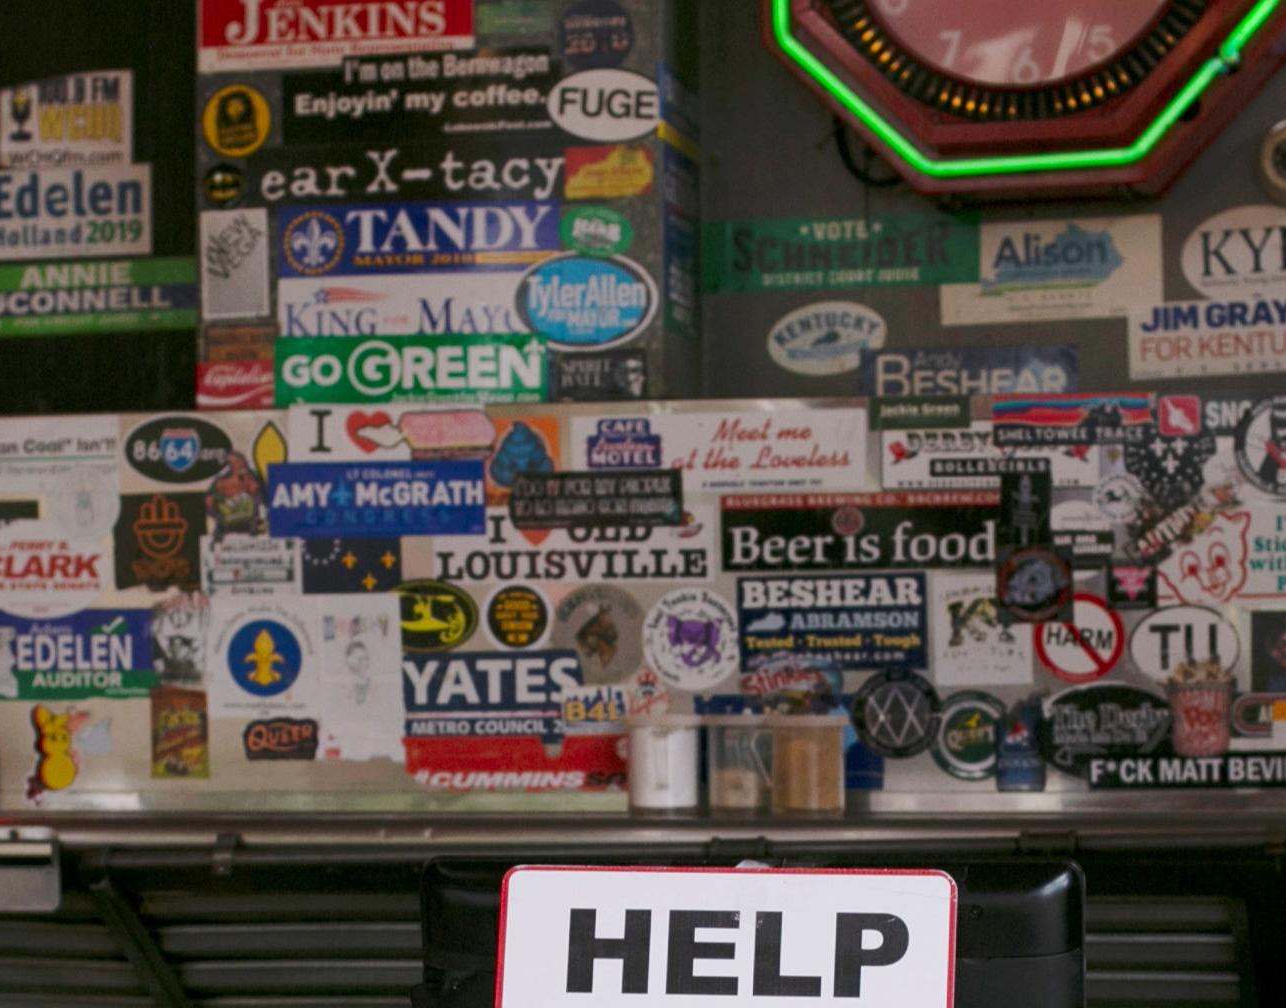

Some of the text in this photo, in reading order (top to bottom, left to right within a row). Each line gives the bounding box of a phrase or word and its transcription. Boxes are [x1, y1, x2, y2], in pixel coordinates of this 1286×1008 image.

[225, 0, 446, 44] JENKINS
[939, 30, 962, 67] 7
[1089, 26, 1114, 58] 5
[344, 55, 439, 83] I'm on the
[1014, 48, 1038, 82] 6
[295, 82, 548, 118] Enjoyin' my coffee.
[559, 88, 657, 119] FUGE
[260, 162, 354, 201] ear
[365, 148, 565, 202] X-tacy
[86, 219, 142, 245] 2019
[345, 205, 551, 254] TANDY
[814, 219, 871, 240] VOTE
[730, 222, 951, 274] SCHNEIDER
[994, 231, 1109, 269] Alison
[21, 262, 133, 289] ANNIE
[762, 269, 823, 287] DISTRICT
[285, 302, 377, 337] KING
[773, 311, 881, 348] KENTUCKY
[1141, 304, 1198, 333] JIM
[1140, 336, 1193, 362] FOR
[282, 340, 546, 395] GO GREEN
[875, 352, 1068, 396] BESHEAR
[599, 419, 648, 435] CAFE
[711, 419, 813, 443] Meet me
[998, 426, 1144, 441] SHELTOWEE TRACE
[591, 450, 657, 466] MOTEL
[671, 446, 852, 471] at the Loveless
[273, 483, 332, 509] AMY
[356, 479, 485, 507] McGRATH
[306, 508, 451, 526] CONGRESS
[730, 520, 996, 564] Beer is food
[437, 548, 708, 581] LOUISVILLE
[742, 577, 922, 609] BESHEAR
[789, 611, 920, 632] ABRAMSON
[16, 633, 133, 671] EDELEN
[746, 634, 921, 650] Tested Trusted Tough
[32, 671, 122, 688] AUDITOR
[402, 658, 581, 705] YATES
[411, 717, 547, 735] METRO COUNCIL
[1160, 757, 1221, 783] MATT
[566, 908, 909, 998] HELP
